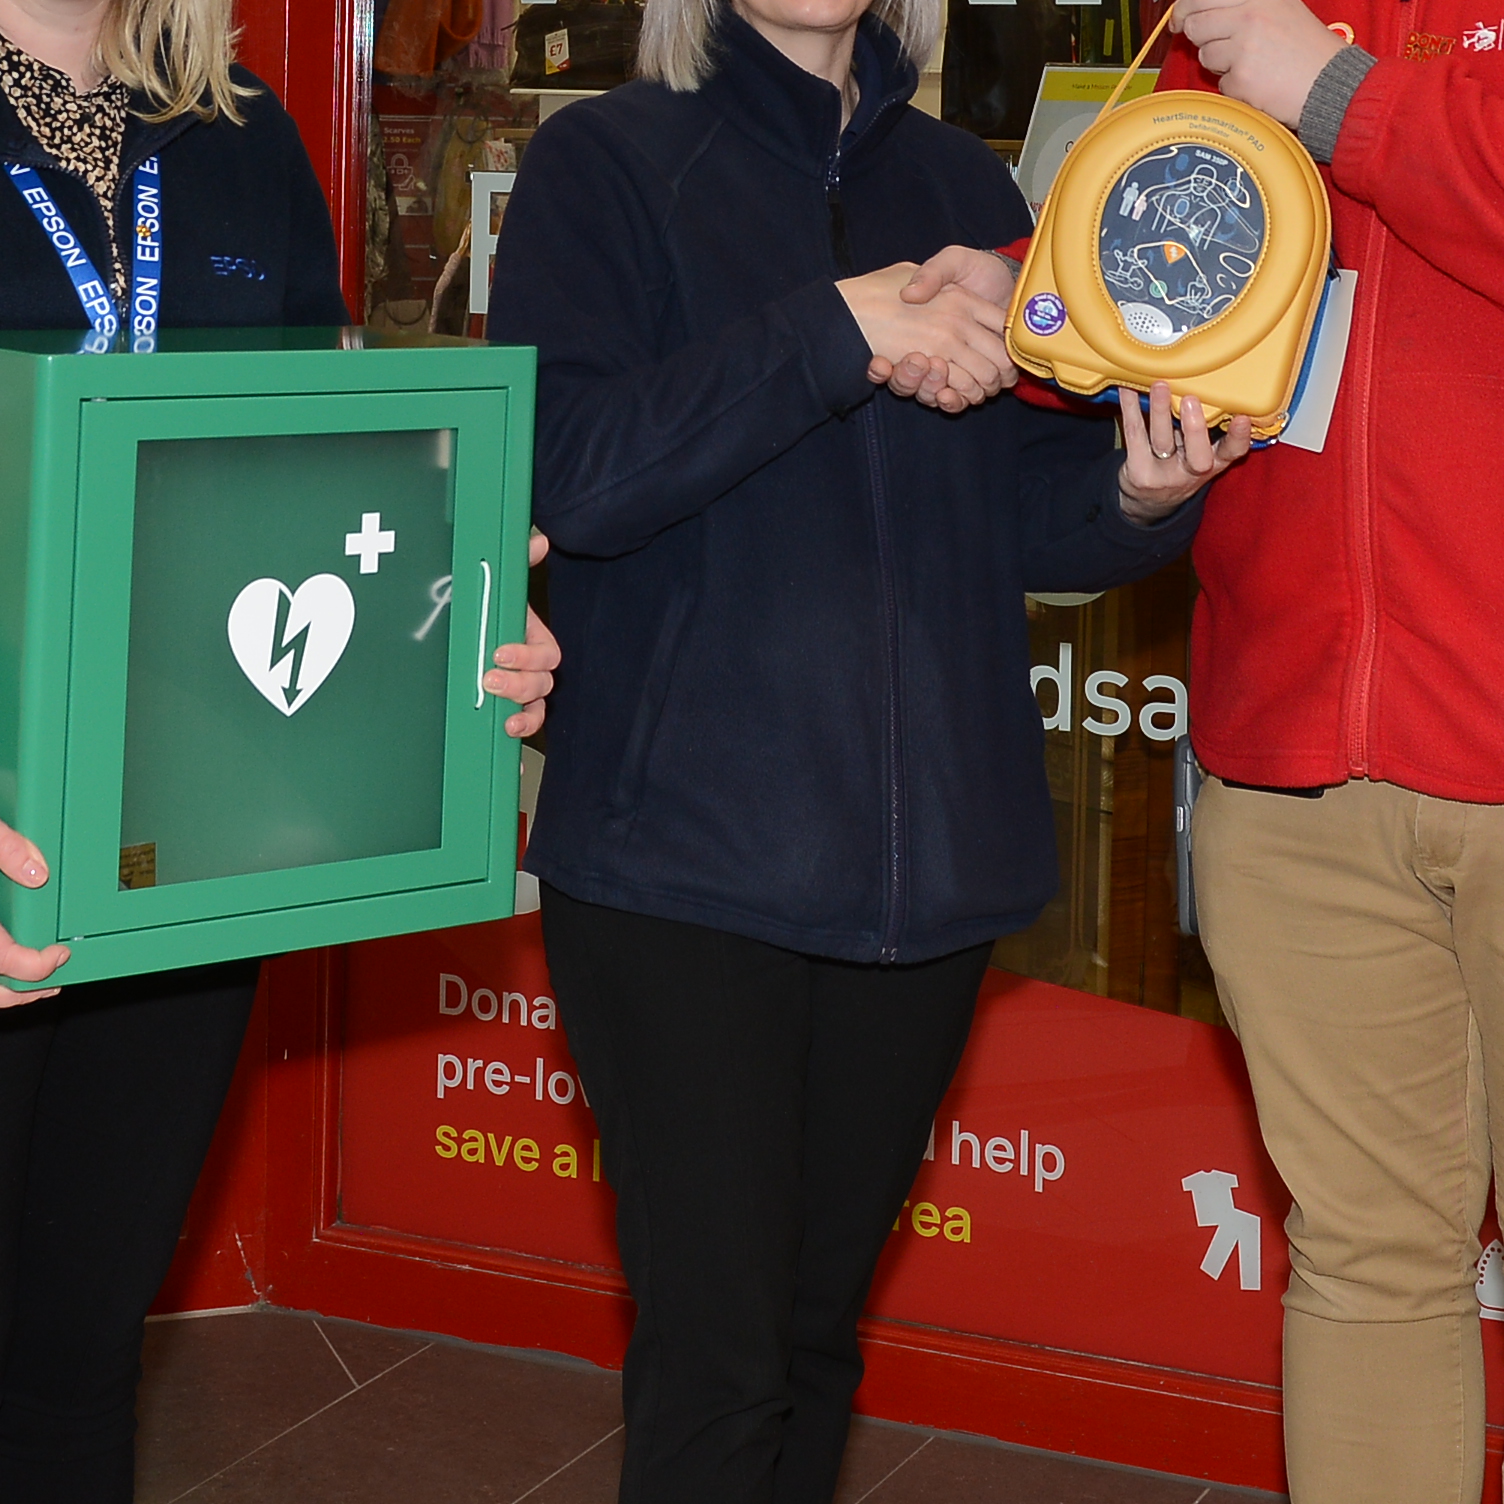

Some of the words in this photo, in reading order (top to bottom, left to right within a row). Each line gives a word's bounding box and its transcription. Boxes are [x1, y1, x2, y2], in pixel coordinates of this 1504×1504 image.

[549, 42, 563, 57] £7
[383, 126, 415, 135] Scarves
[402, 136, 422, 144] Each
[1152, 112, 1199, 125] HeartSine
[1247, 134, 1265, 153] PAD
[1189, 122, 1230, 139] Defibrillator
[22, 186, 87, 268] EPSON
[435, 1122, 540, 1173] save
[553, 1139, 579, 1180] a
[952, 1121, 1066, 1193] help
